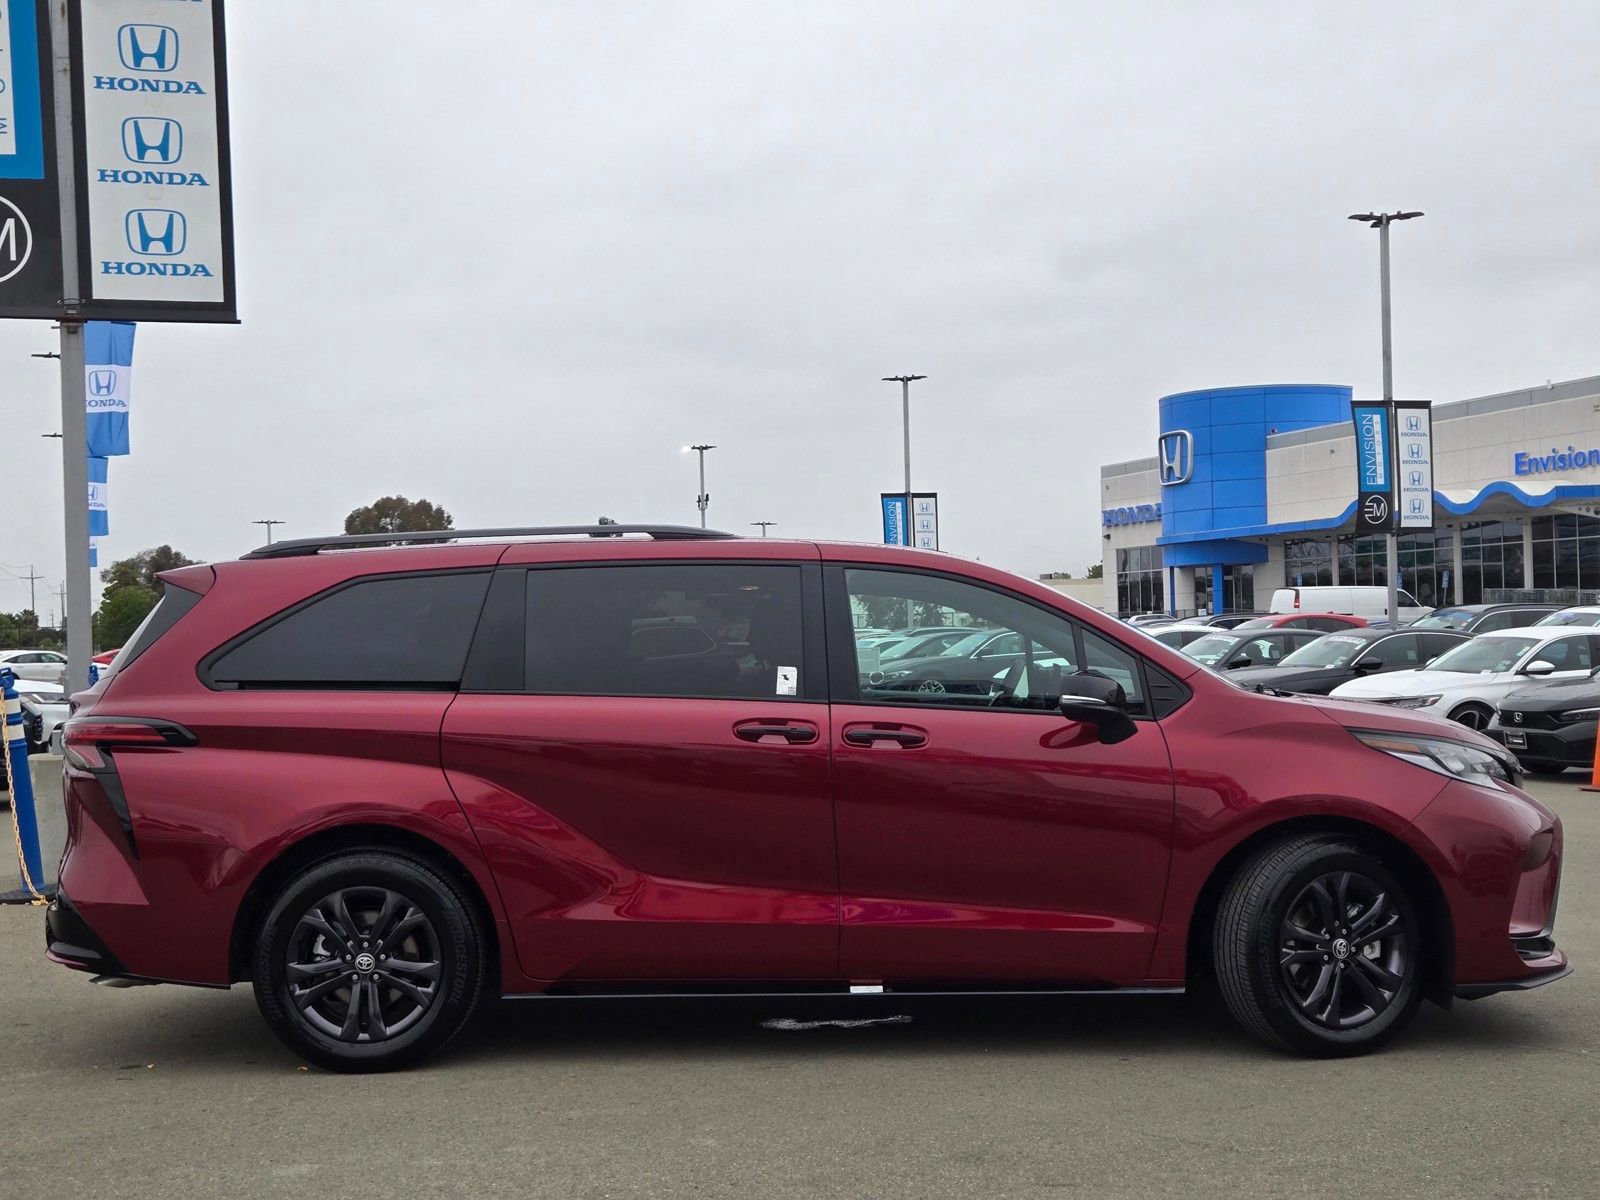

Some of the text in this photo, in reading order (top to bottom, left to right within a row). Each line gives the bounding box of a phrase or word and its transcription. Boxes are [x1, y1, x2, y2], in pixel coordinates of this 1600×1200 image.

[93, 75, 206, 95] HONDA
[97, 169, 210, 187] HONDA
[101, 261, 214, 277] HONDA
[87, 399, 127, 408] ONDA
[1362, 414, 1377, 485] ENVISION
[1514, 446, 1600, 476] Envision
